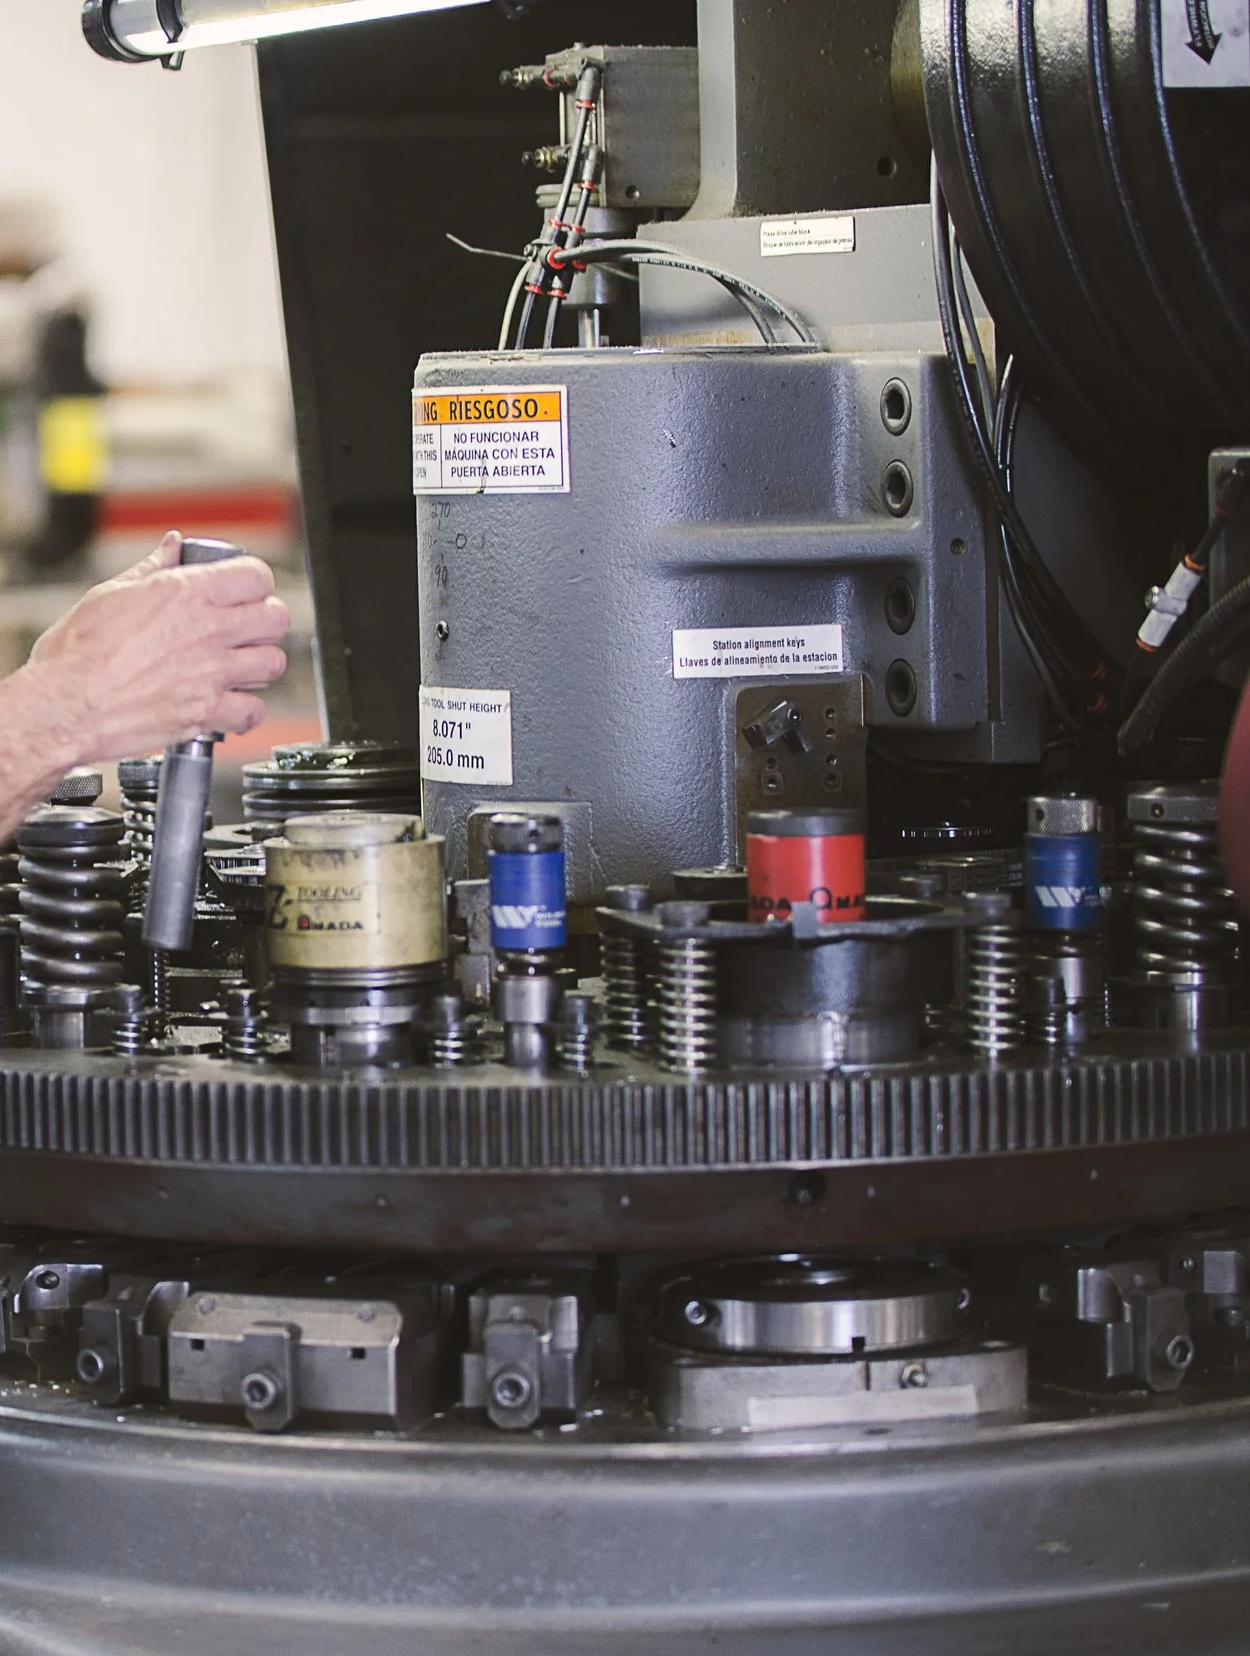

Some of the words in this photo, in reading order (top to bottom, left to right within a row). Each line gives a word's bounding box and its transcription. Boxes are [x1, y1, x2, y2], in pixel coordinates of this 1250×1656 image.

[450, 398, 539, 421] RIESGOSO
[453, 433, 467, 445] NO
[470, 431, 540, 444] FUNCIONAR
[424, 450, 437, 461] THIS
[492, 449, 518, 460] CON
[522, 448, 556, 459] ESTA
[450, 466, 490, 478] PUERTA
[492, 465, 546, 477] ABIERTA
[713, 640, 742, 651] Station
[744, 638, 785, 651] alignment
[786, 636, 805, 650] keys
[679, 657, 709, 667] Llaves
[711, 656, 722, 666] de
[724, 654, 778, 666] alineamiento
[780, 653, 790, 664] de
[792, 653, 800, 663] la
[802, 652, 838, 663] estacion
[431, 698, 445, 709] TOOL
[447, 700, 466, 711] SHUT
[470, 702, 502, 713] HEIGHT
[432, 718, 471, 739] 8.071"
[427, 745, 454, 766] 205.0
[457, 753, 485, 769] mm
